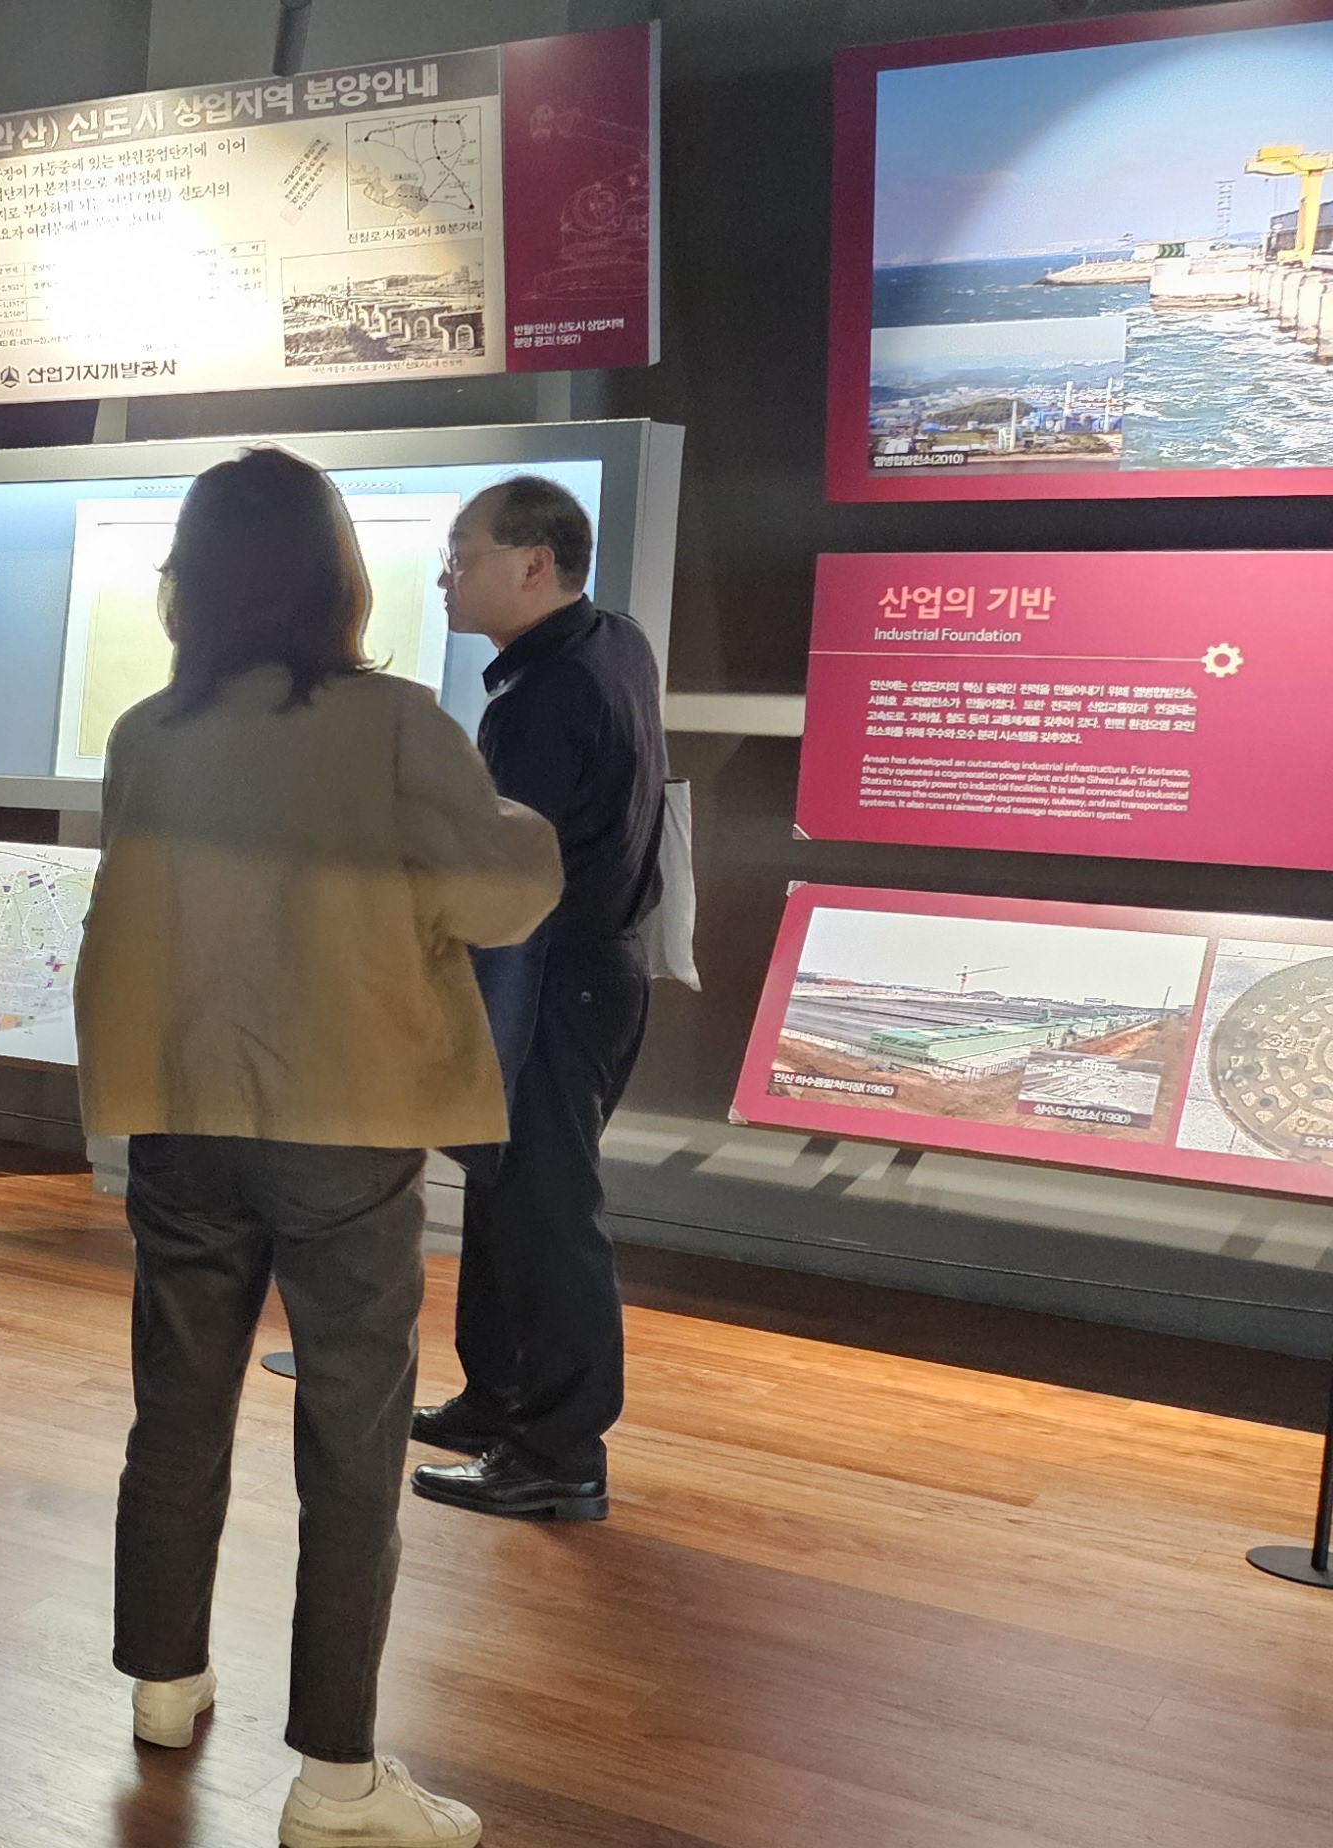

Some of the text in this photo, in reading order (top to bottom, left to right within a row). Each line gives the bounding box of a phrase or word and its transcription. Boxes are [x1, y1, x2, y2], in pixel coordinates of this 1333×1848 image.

[67, 100, 164, 143] 신도시
[173, 84, 294, 128] 상업지역
[303, 63, 439, 111] 분양안내
[32, 156, 84, 177] 가동중에
[88, 155, 115, 171] 있는
[118, 141, 207, 166] 반월공업단지에
[217, 137, 246, 155] 이어
[165, 164, 193, 181] 따라
[178, 182, 230, 201] 신도시의
[347, 230, 382, 244] 전철로
[383, 226, 431, 241] 서울에서
[557, 320, 585, 333] 신도시
[26, 359, 178, 385] 산업기지개발공사
[878, 586, 1057, 620] 산업의 기반
[874, 627, 1022, 643] Industrial Foundation
[911, 680, 960, 693] 산업단지의
[1053, 684, 1105, 697] 만들어내기
[1108, 685, 1130, 698] 위해
[1023, 699, 1046, 712] 또한
[862, 753, 890, 764] Ansan
[891, 755, 908, 765] has
[908, 756, 954, 768] developed
[954, 758, 966, 768] an
[967, 758, 1021, 771] outstanding
[1021, 761, 1063, 772] industrial
[1130, 764, 1147, 775] For
[862, 765, 878, 775] the
[878, 766, 895, 777] city
[895, 767, 934, 779] operates
[941, 770, 998, 780] cogeneration
[998, 772, 1027, 783] power
[1027, 772, 1051, 784] plant
[1051, 774, 1069, 784] and
[1070, 774, 1086, 784] the
[1086, 775, 1115, 787] Sihwa
[1115, 776, 1137, 787] Lake
[1138, 777, 1160, 788] Tidal
[1160, 778, 1190, 789] Power
[860, 775, 892, 786] Station
[893, 777, 903, 787] to
[903, 778, 931, 790] supply
[931, 780, 958, 791] power
[958, 780, 968, 790] to
[969, 781, 1009, 792] industrial
[1067, 785, 1085, 795] well
[1086, 786, 1134, 798] connected
[1135, 788, 1145, 798] to
[1146, 789, 1189, 801] industrial
[859, 787, 882, 797] sites
[882, 788, 911, 798] across
[912, 788, 927, 798] the
[927, 790, 962, 802] country
[962, 790, 996, 803] through
[1088, 797, 1105, 808] and
[1106, 798, 1120, 809] rail
[1121, 799, 1188, 812] transportation
[906, 800, 925, 810] also
[925, 802, 945, 811] runs
[952, 802, 994, 814] rainwater
[994, 804, 1011, 815] and
[1011, 806, 1047, 818] sewage
[1047, 808, 1095, 820] separation
